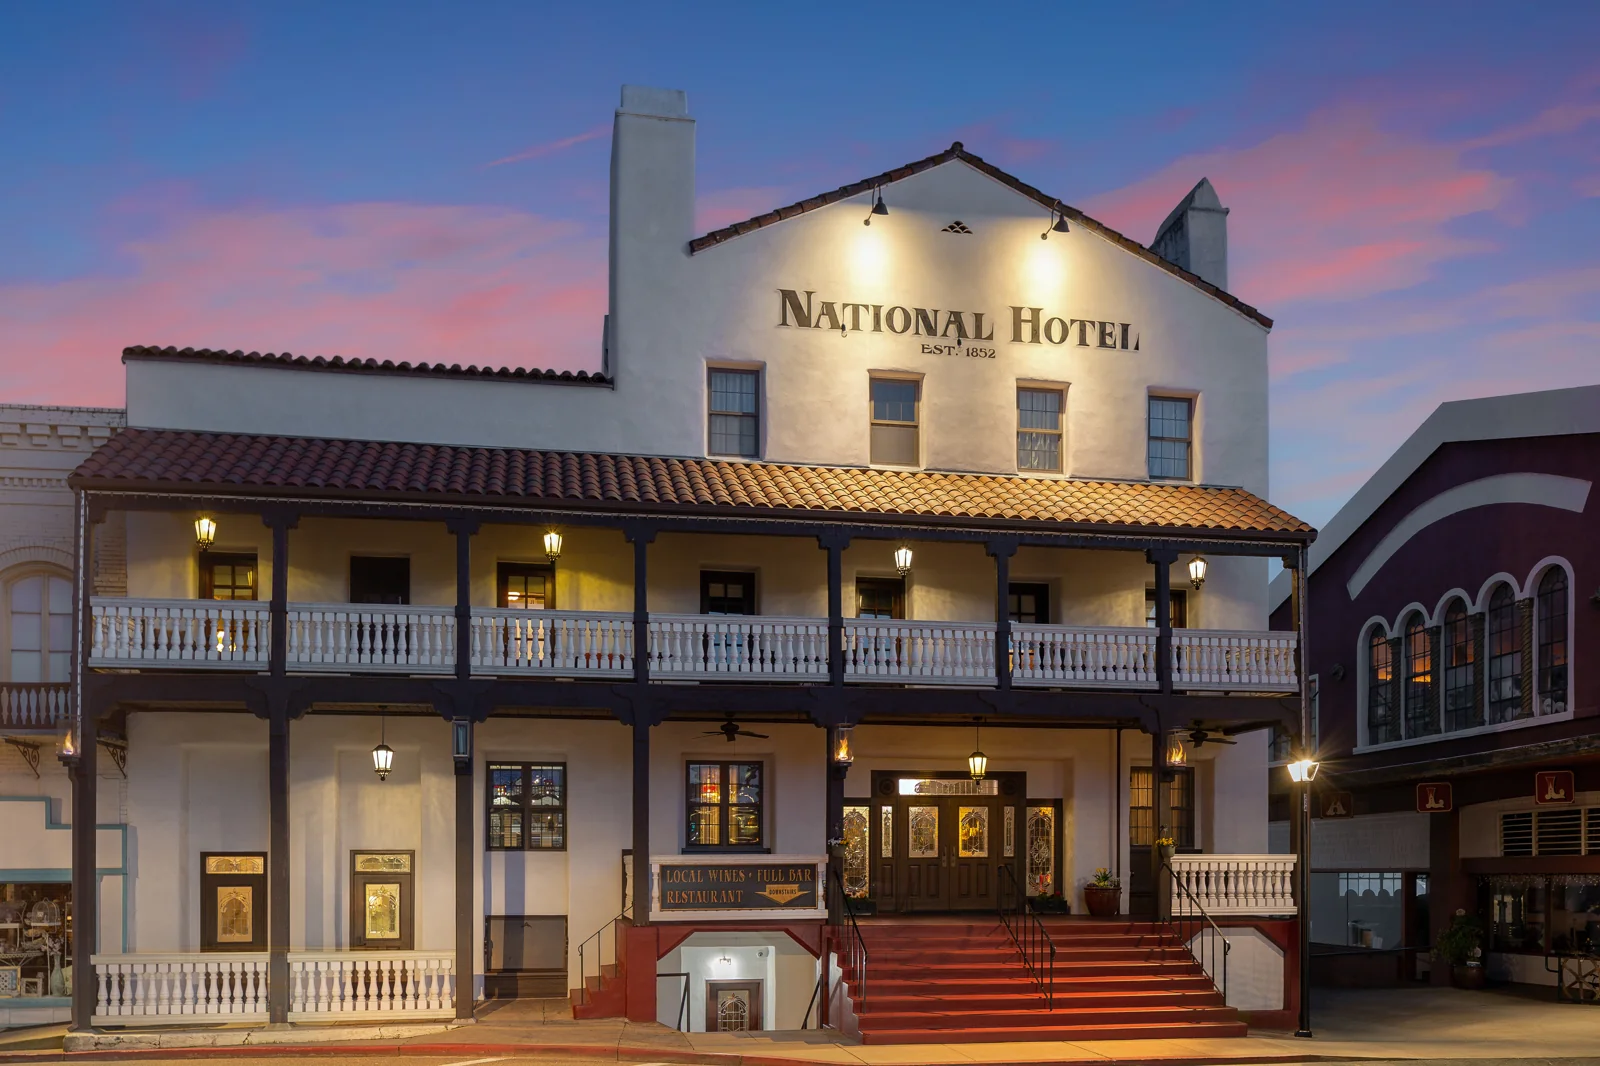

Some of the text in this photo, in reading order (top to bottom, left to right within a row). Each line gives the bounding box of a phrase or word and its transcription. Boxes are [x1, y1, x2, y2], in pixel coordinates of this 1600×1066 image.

[777, 288, 1140, 351] NATIONAL HOTEL
[921, 344, 996, 359] EST. 1852
[666, 868, 813, 883] LOCAL WINES FULL BAR
[666, 890, 744, 904] RESTAURANT
